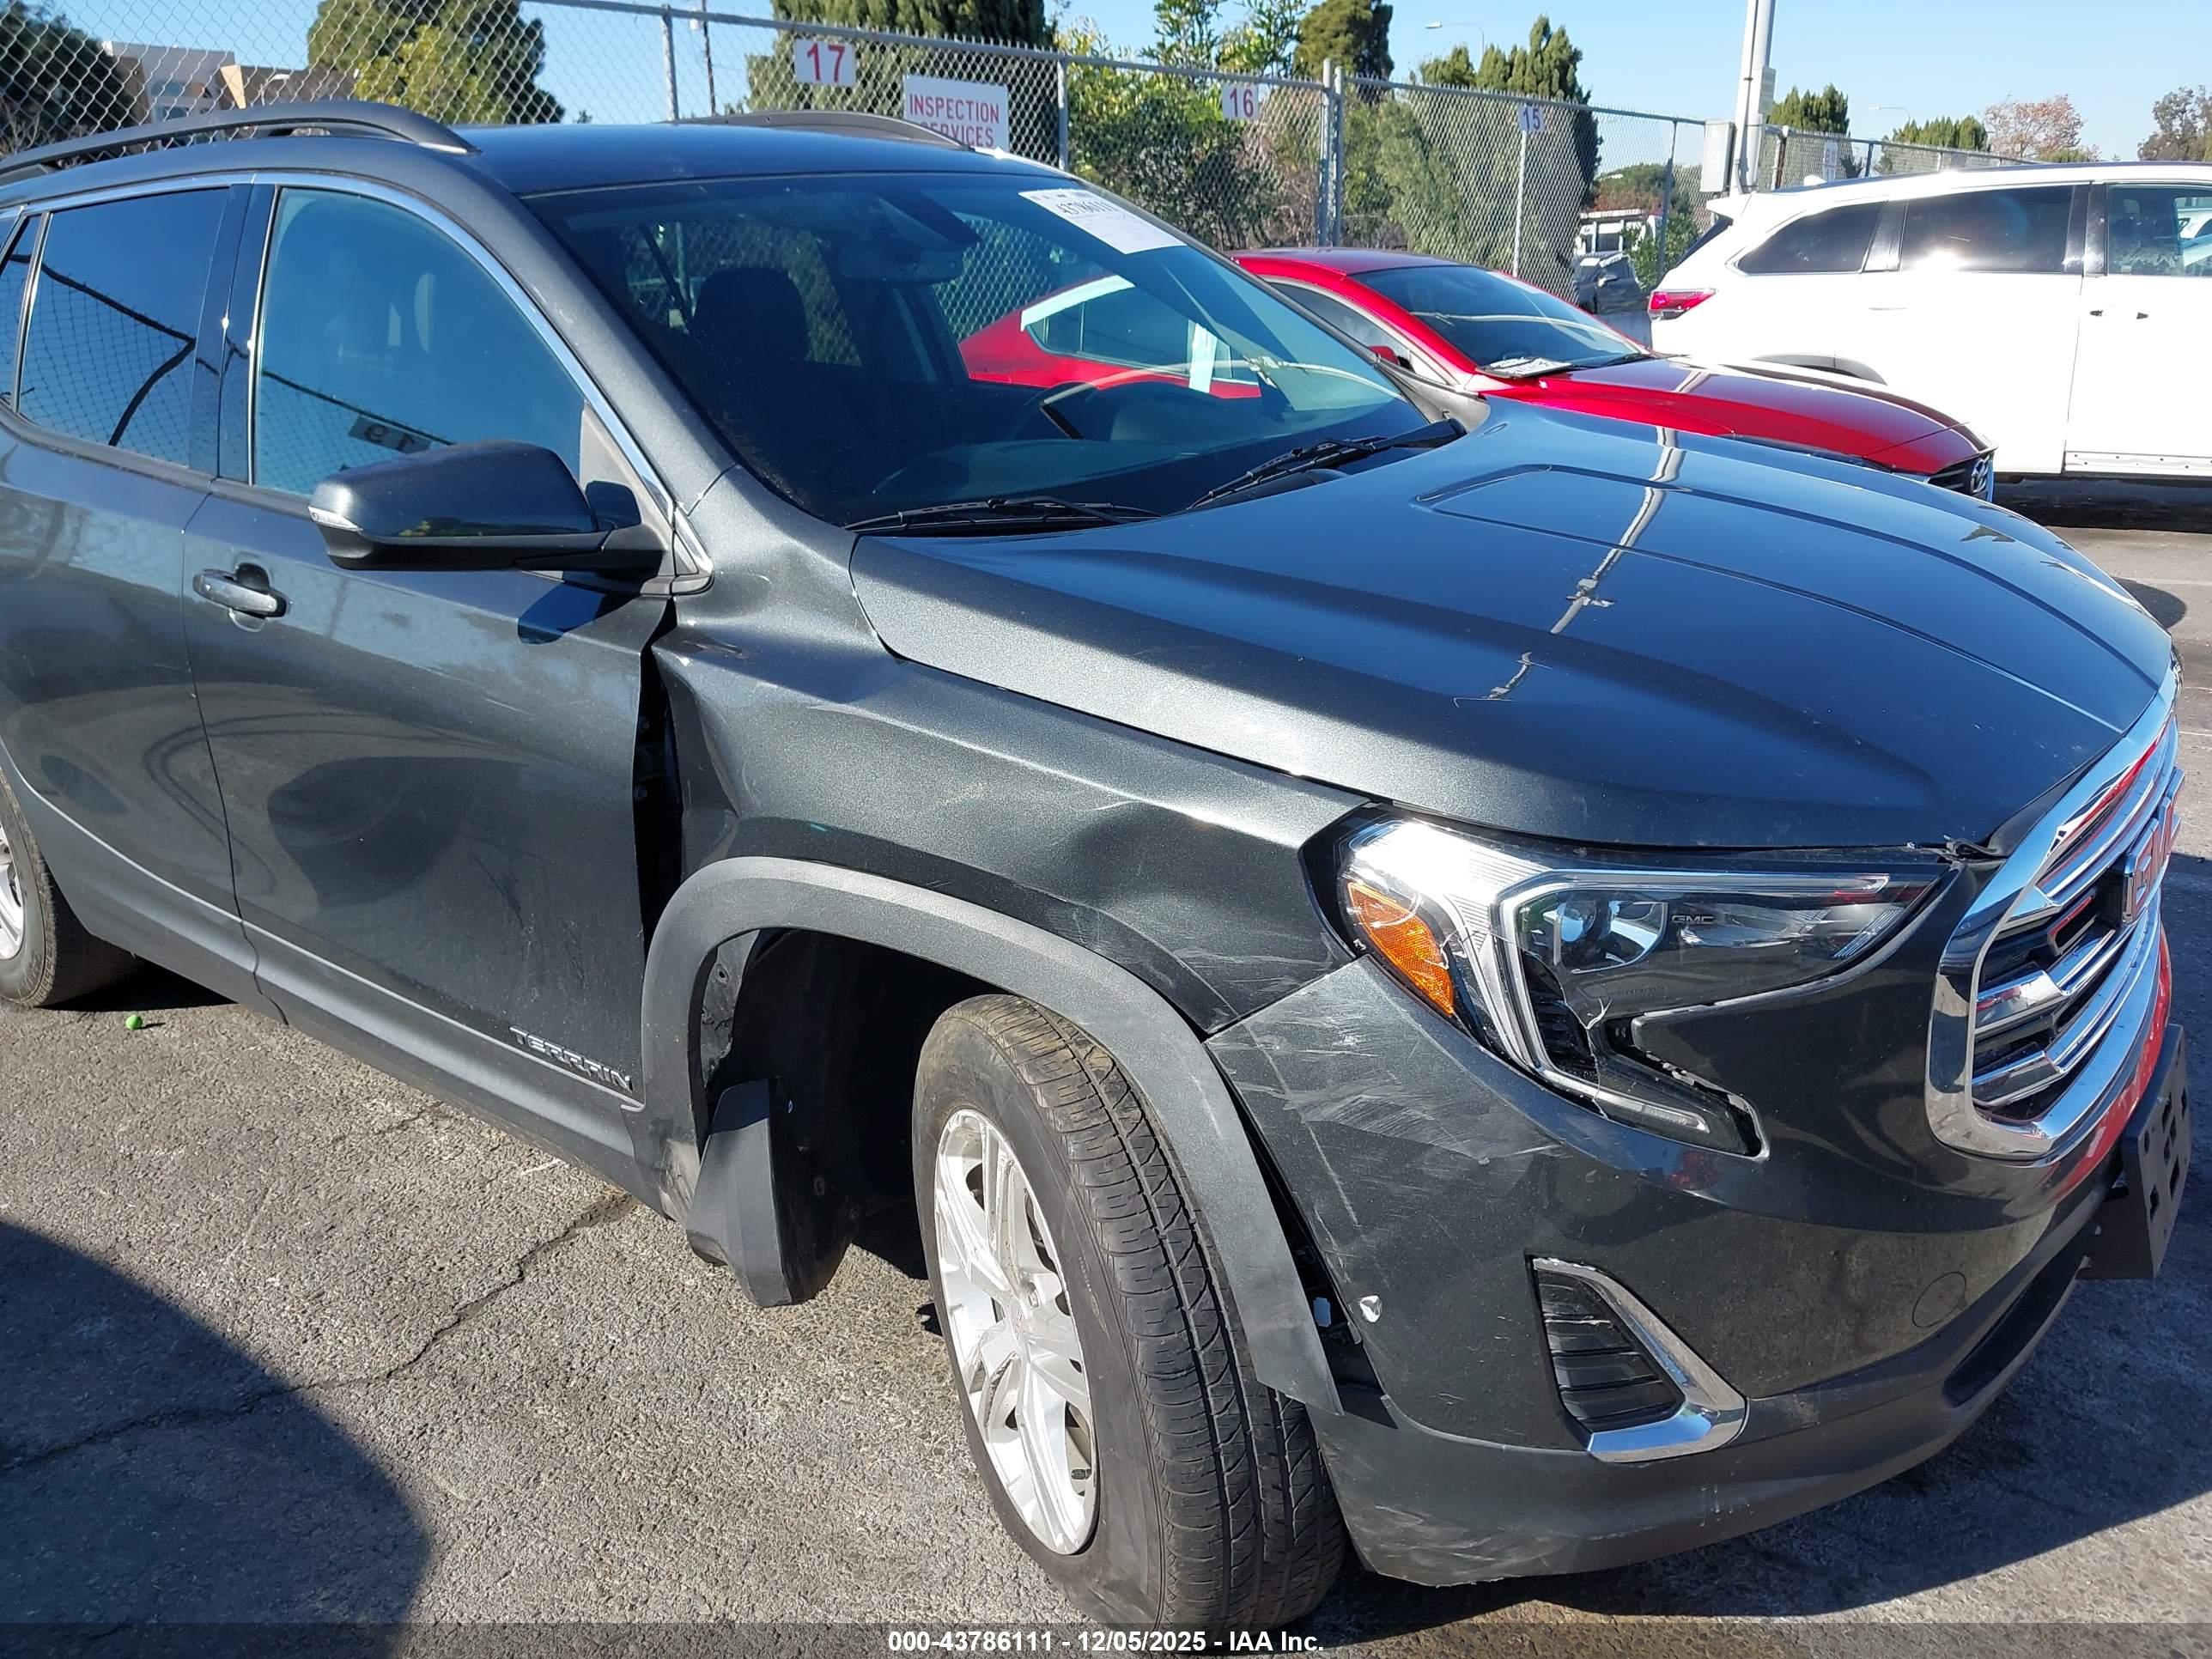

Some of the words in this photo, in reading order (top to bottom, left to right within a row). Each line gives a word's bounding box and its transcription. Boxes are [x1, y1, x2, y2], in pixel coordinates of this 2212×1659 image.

[806, 43, 846, 82] 17
[908, 94, 1000, 125] INSPECTION
[1230, 88, 1254, 118] 16
[1523, 107, 1540, 131] 15
[921, 121, 994, 148] RVICES
[1672, 915, 1714, 925] GMC
[509, 1026, 634, 1093] TERRAIN
